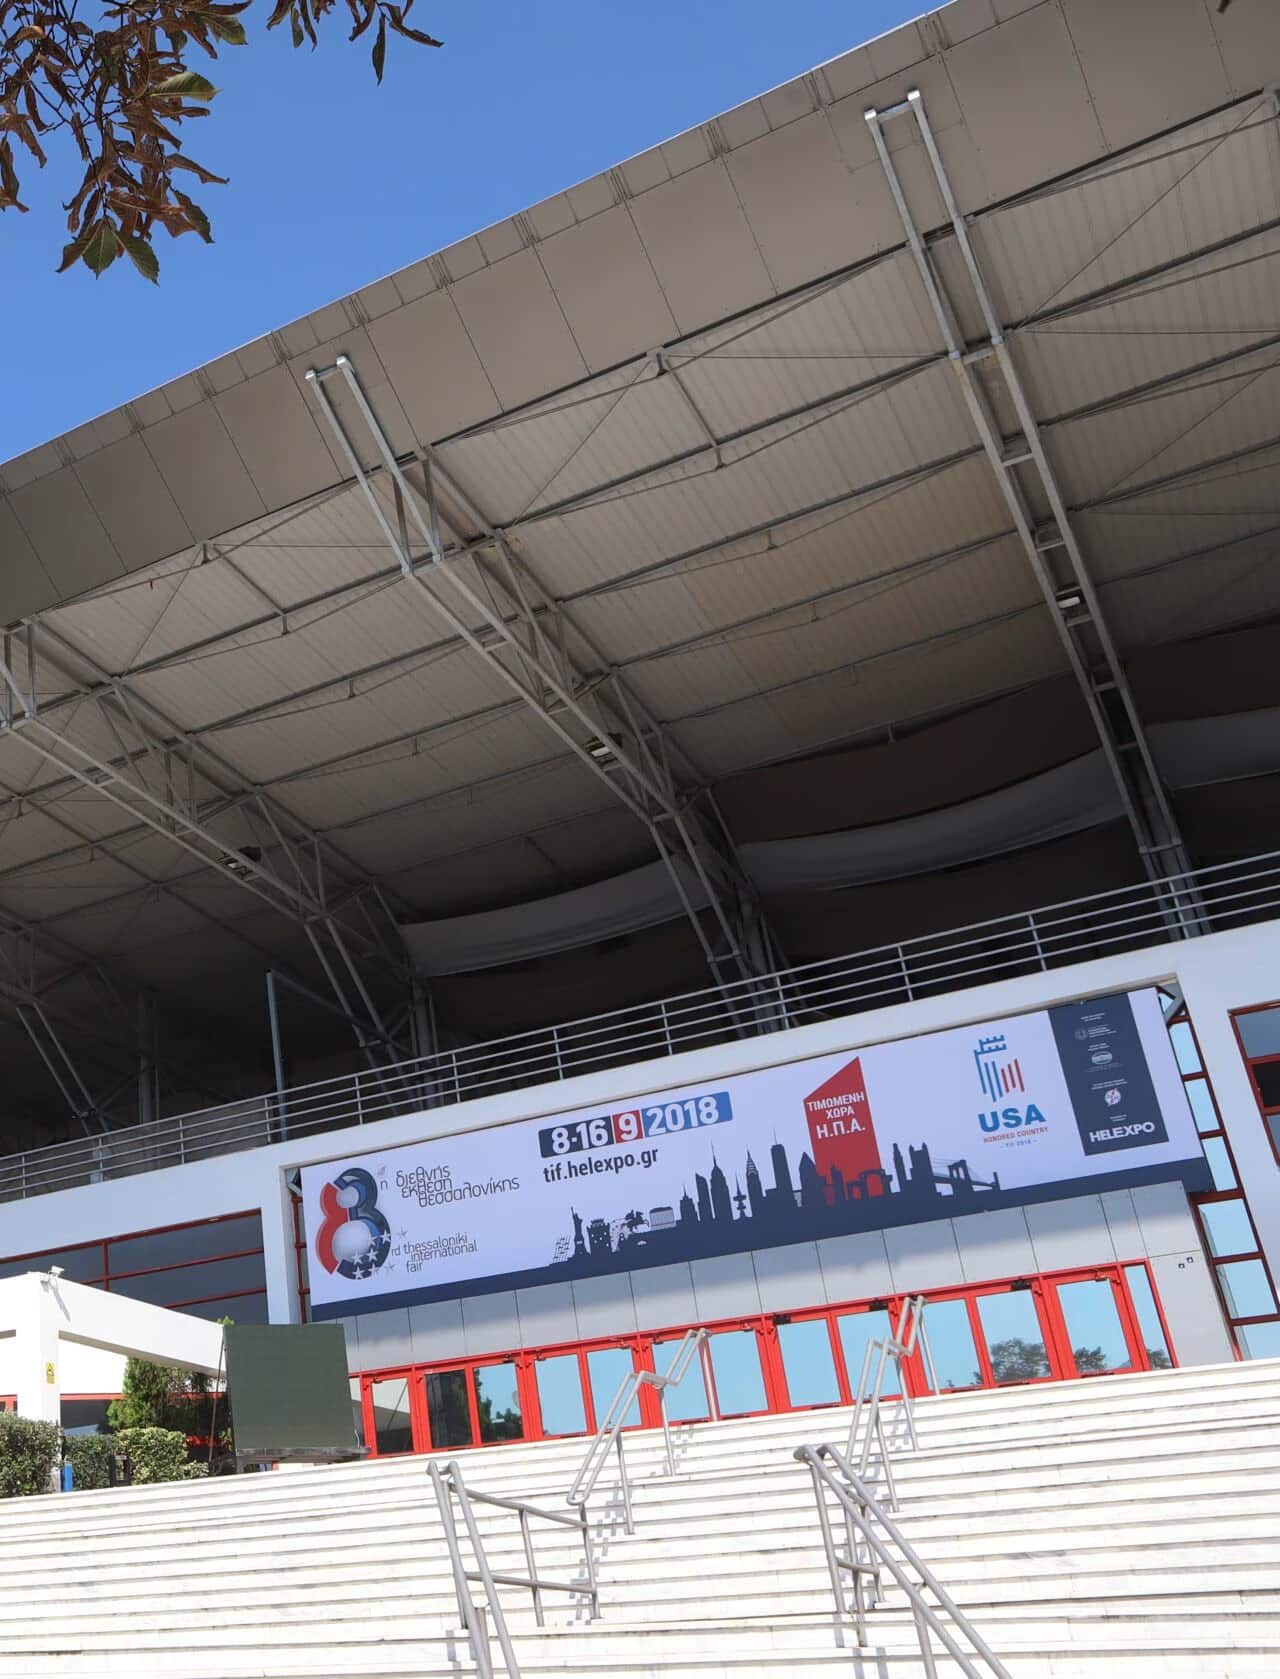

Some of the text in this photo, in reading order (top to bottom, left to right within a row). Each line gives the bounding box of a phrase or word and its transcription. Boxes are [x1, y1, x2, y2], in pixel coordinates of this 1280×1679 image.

[806, 1091, 865, 1111] ΤΙΜΩΜΕΝΗ
[826, 1105, 855, 1119] ΧΩΡΑ
[618, 1113, 638, 1141] 9
[645, 1096, 719, 1137] 2018
[816, 1118, 866, 1139] Η.Π.Α.
[978, 1104, 1047, 1132] USA
[1017, 1126, 1049, 1137] COUNTRY
[1089, 1121, 1155, 1143] HELEXPO
[543, 1149, 658, 1183] tif.helexpo.gr
[403, 1232, 468, 1254] thessaloniki
[410, 1240, 478, 1262] international
[406, 1260, 423, 1272] fair
